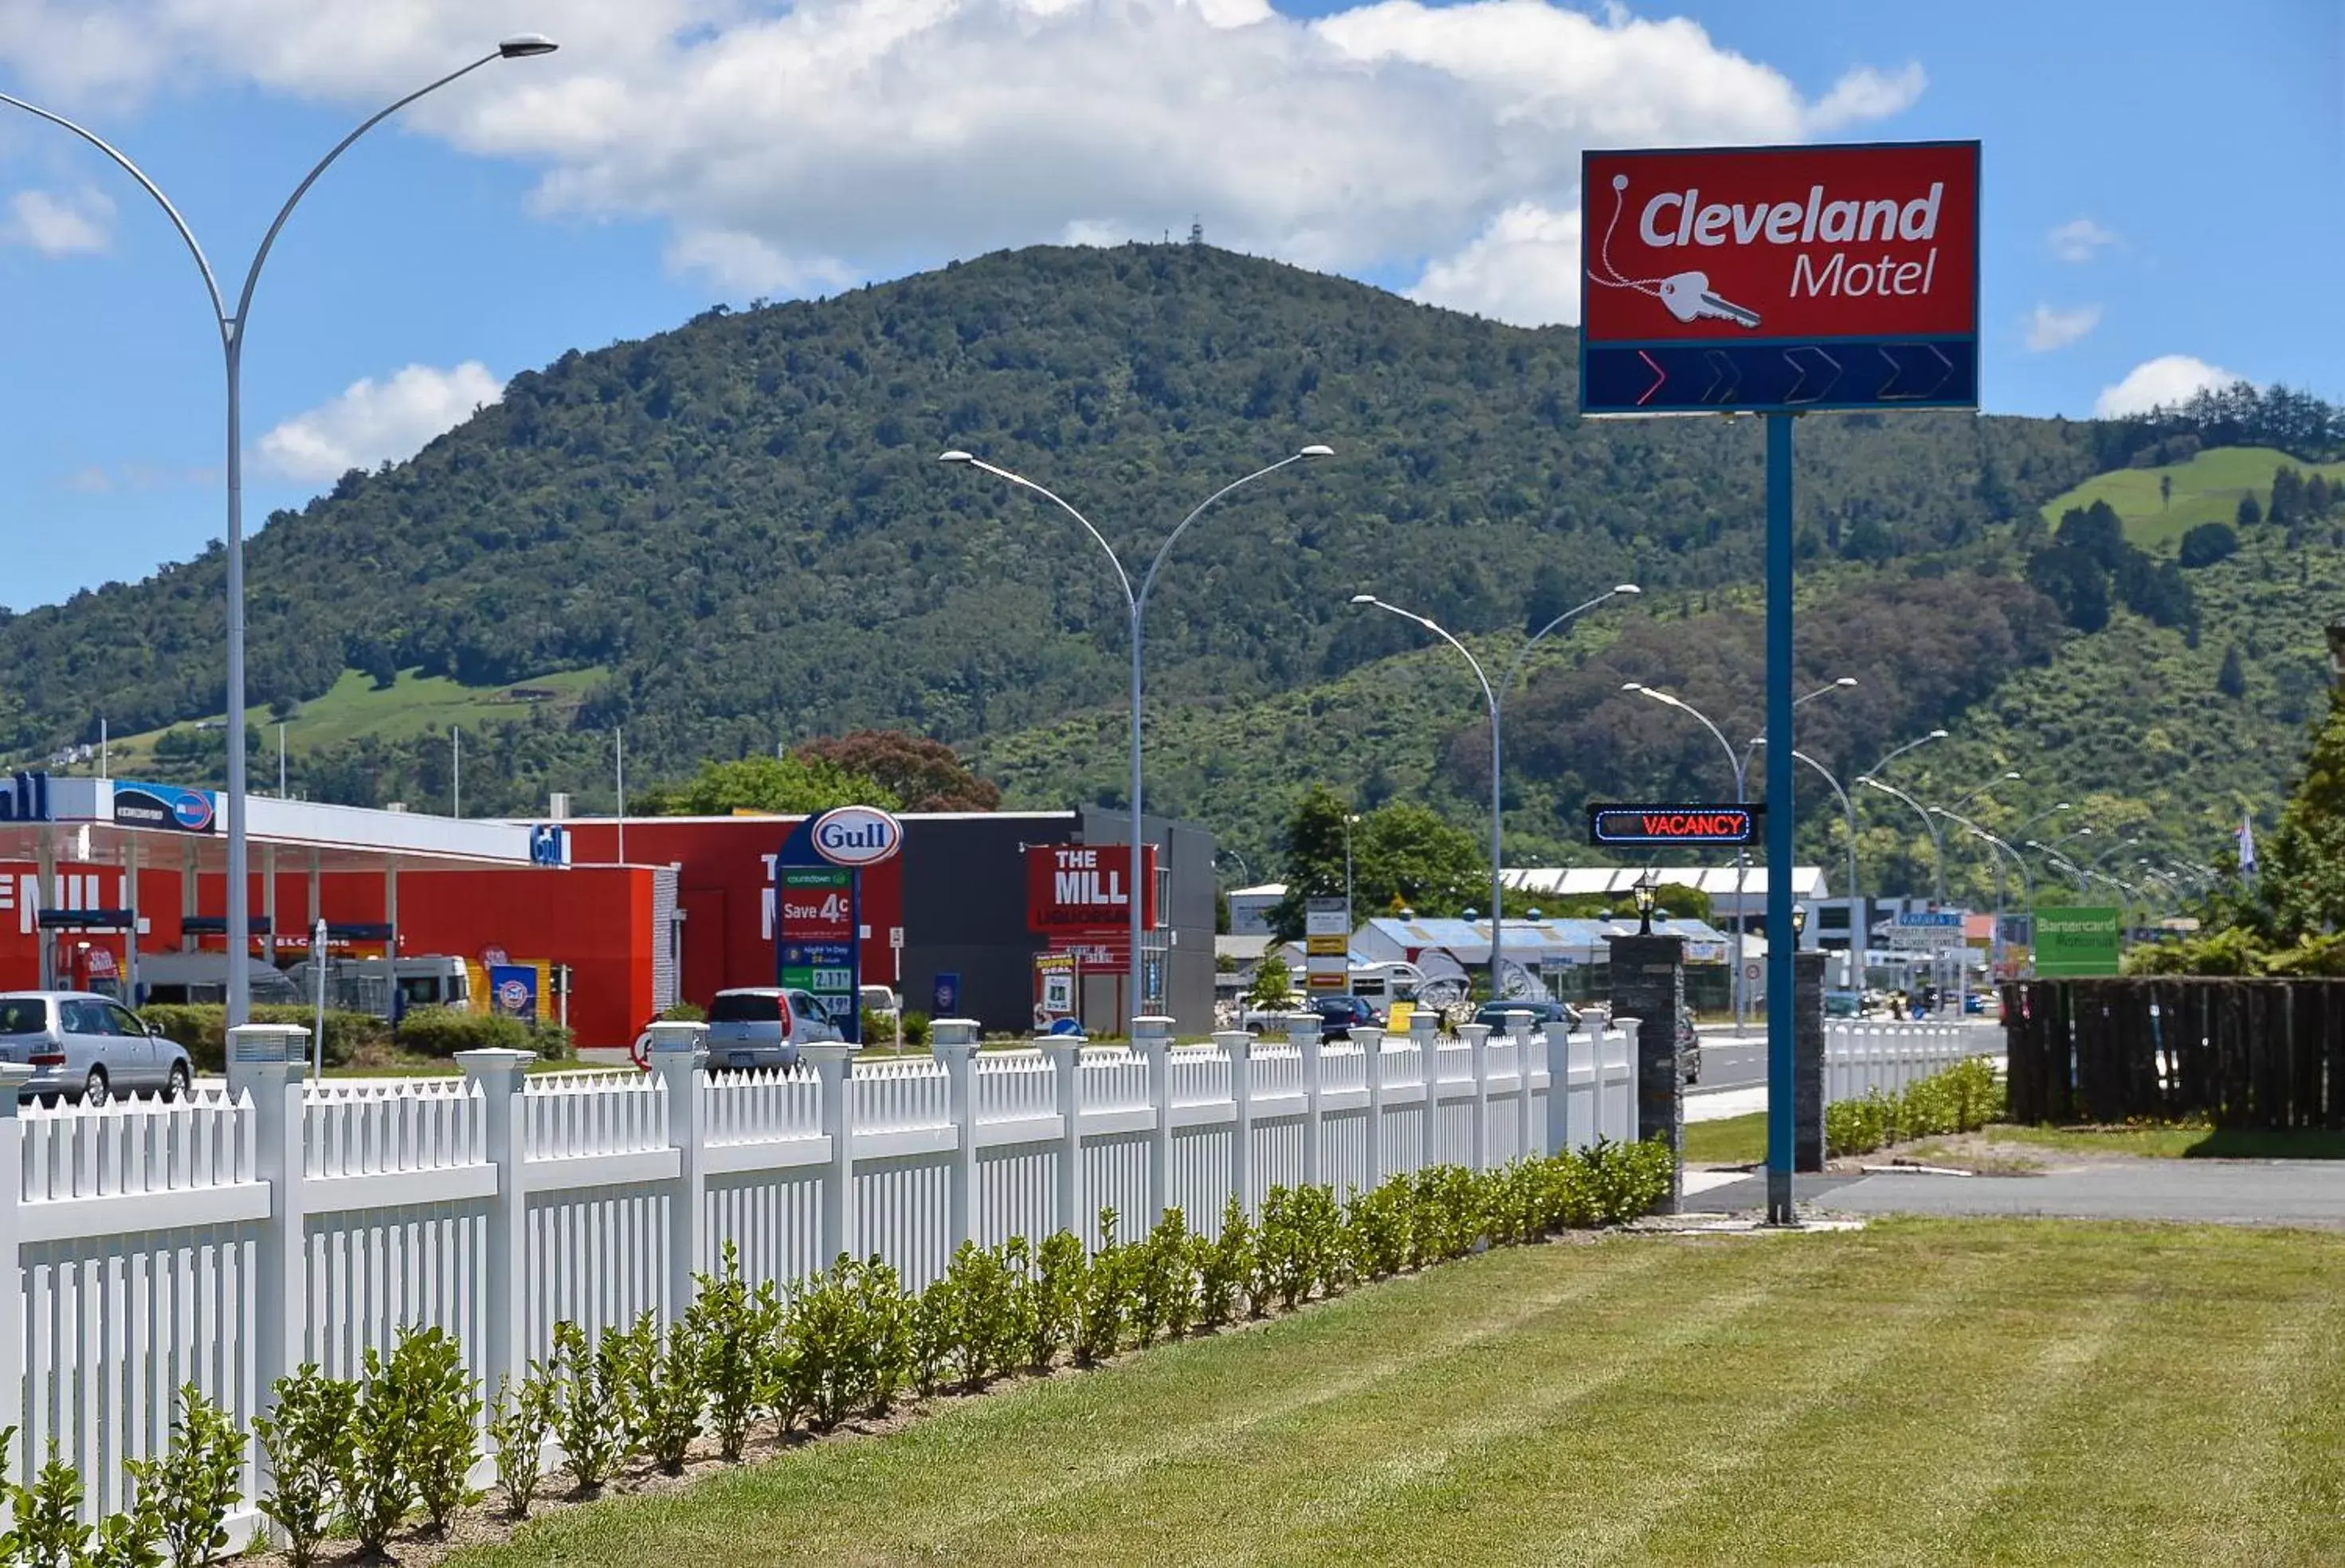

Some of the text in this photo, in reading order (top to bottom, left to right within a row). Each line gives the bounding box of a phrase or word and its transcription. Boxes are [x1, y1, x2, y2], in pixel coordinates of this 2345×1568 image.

[1639, 182, 1944, 248] Cleveland
[1789, 247, 1938, 299] Motel
[820, 822, 886, 849] Gull
[1641, 815, 1743, 836] VACANCY
[1055, 850, 1097, 868] THE
[1055, 870, 1128, 905] MILL
[784, 903, 818, 919] Save
